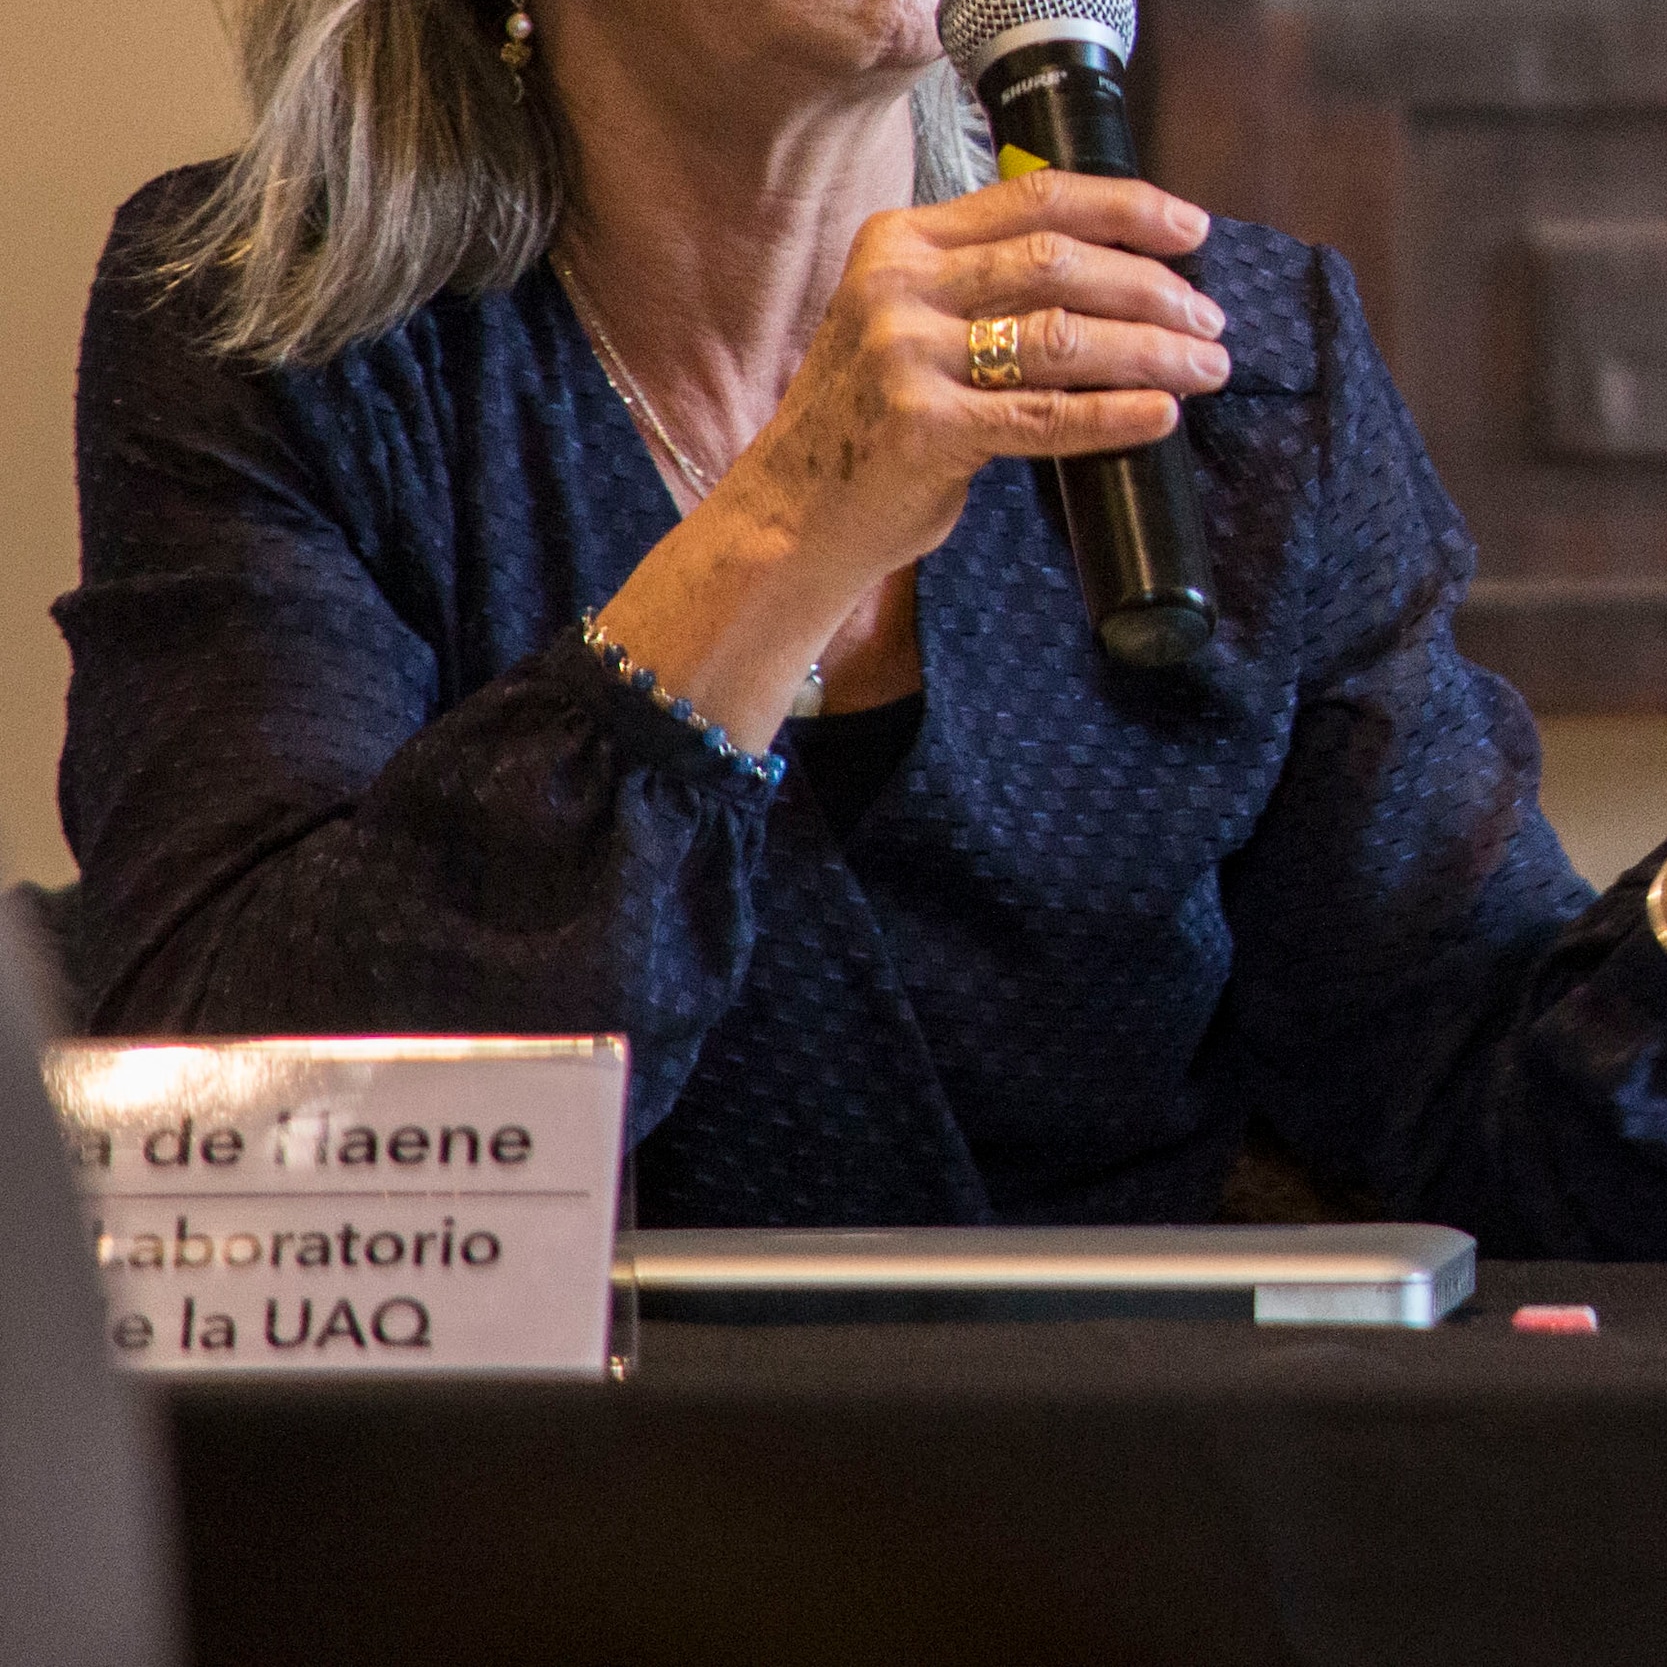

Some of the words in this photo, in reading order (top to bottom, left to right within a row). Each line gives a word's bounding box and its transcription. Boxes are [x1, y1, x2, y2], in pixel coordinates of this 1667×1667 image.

[144, 1111, 244, 1167] de
[180, 1296, 237, 1351] la
[264, 1294, 432, 1351] UAQ
